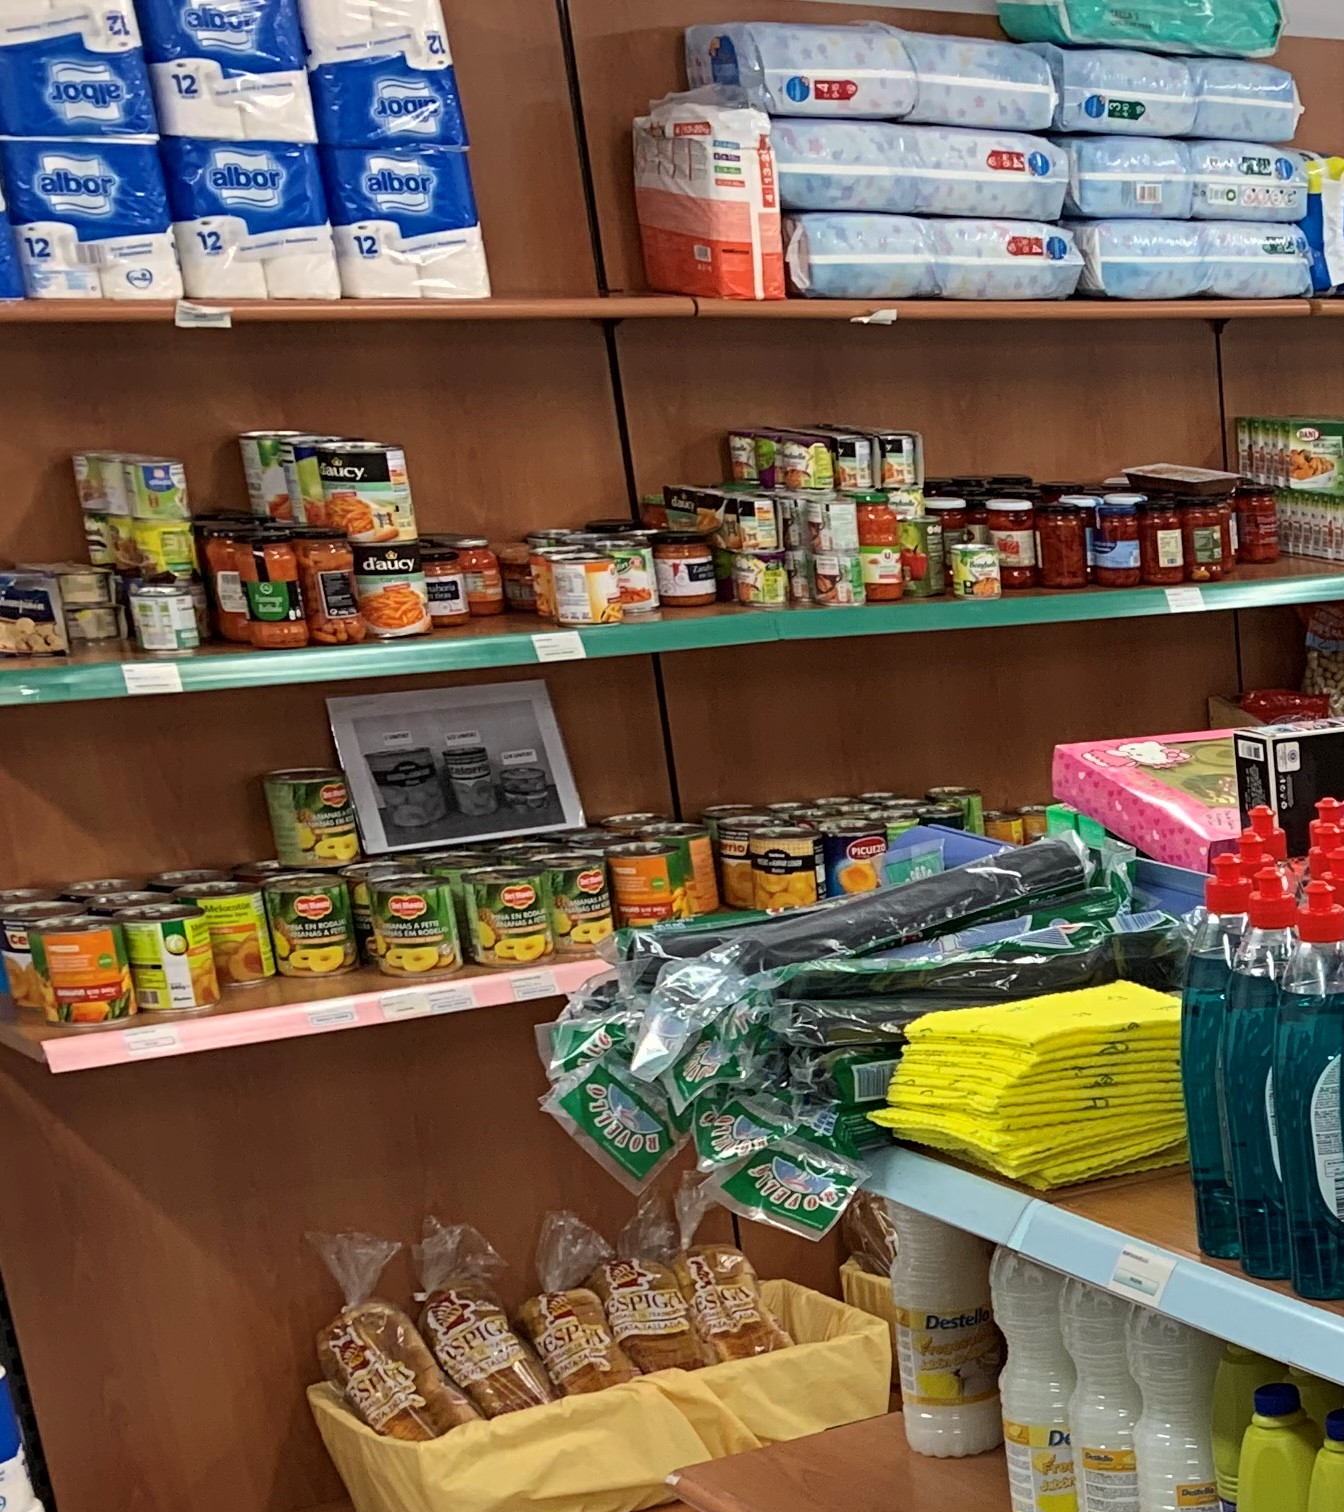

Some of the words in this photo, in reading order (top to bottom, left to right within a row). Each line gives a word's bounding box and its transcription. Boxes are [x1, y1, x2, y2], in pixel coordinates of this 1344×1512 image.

[50, 83, 124, 104] albor
[172, 75, 198, 94] 12
[40, 171, 114, 197] albor
[211, 165, 282, 191] albor
[367, 169, 432, 195] albor
[24, 237, 50, 258] 12
[199, 231, 222, 252] 12
[355, 235, 377, 256] 12
[1299, 430, 1317, 439] DANI
[363, 557, 414, 571] d'aucy
[926, 1309, 990, 1330] Destello
